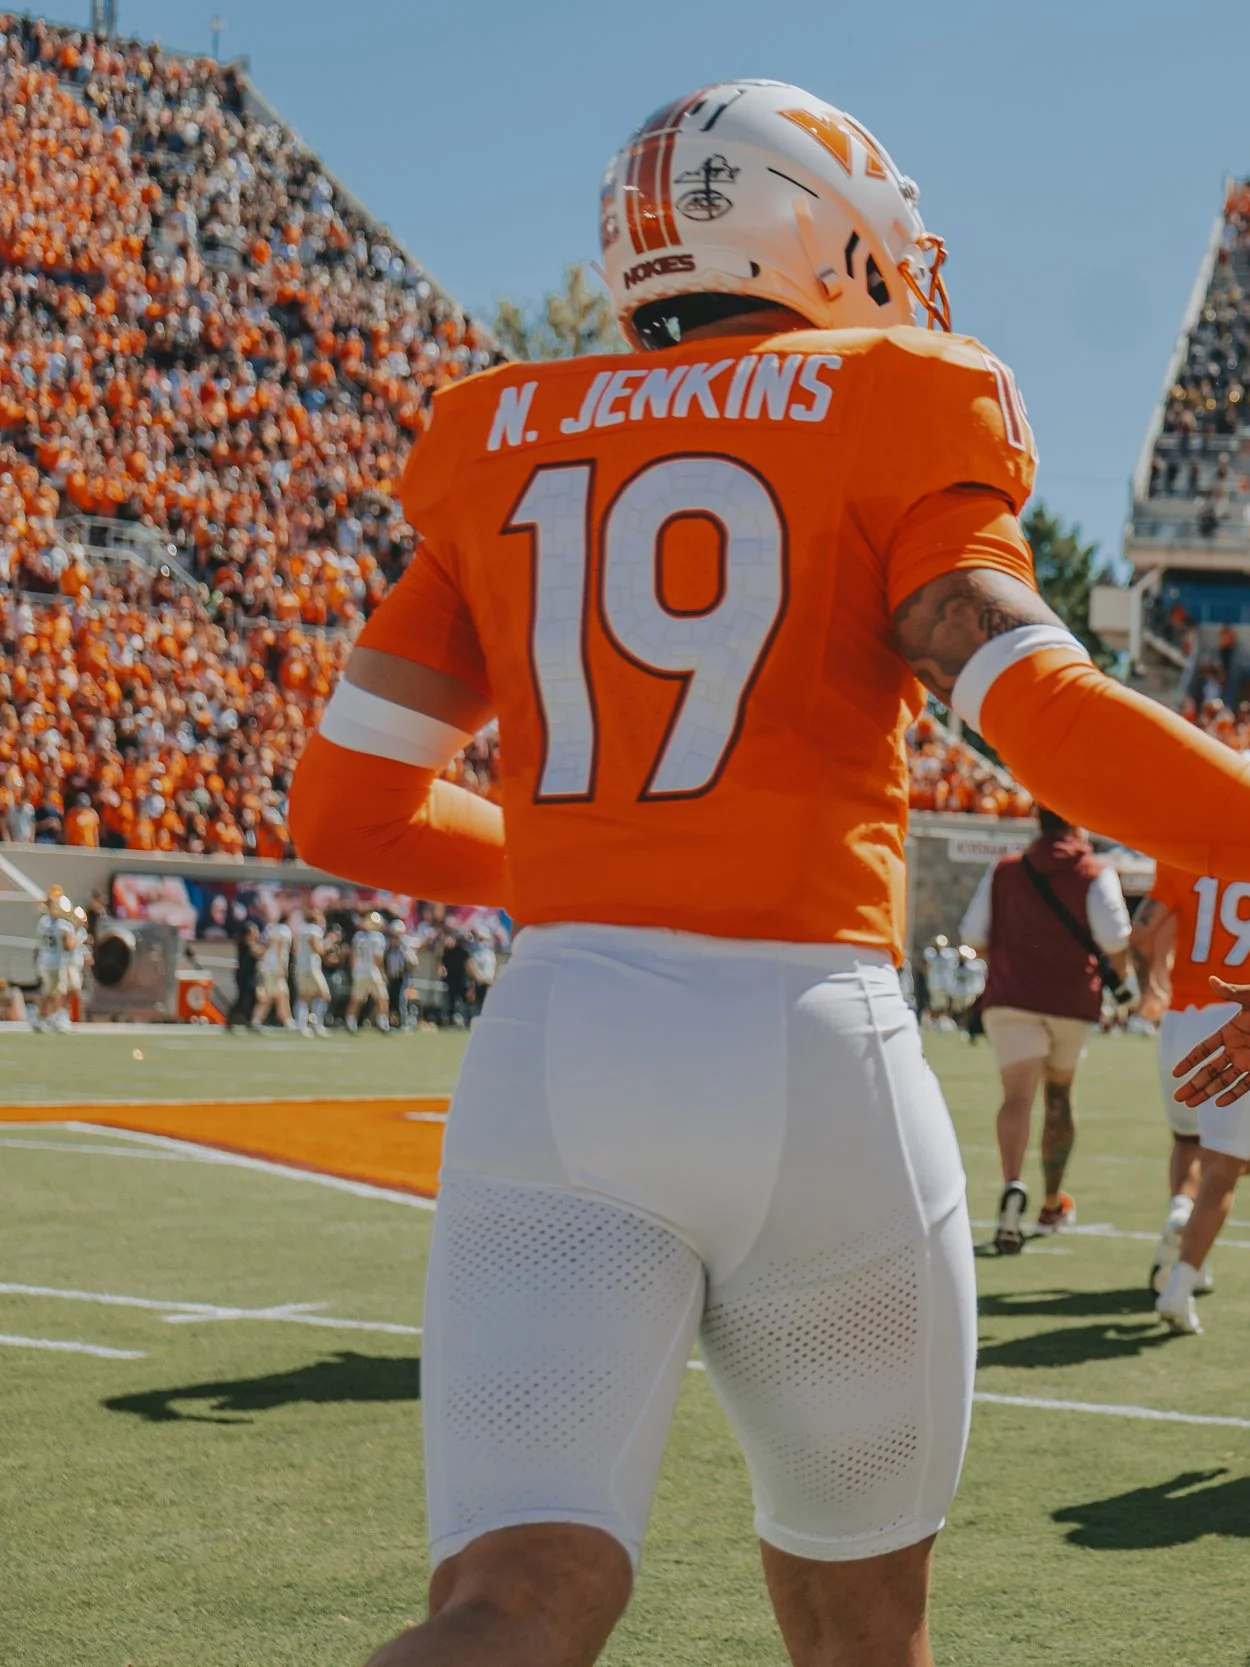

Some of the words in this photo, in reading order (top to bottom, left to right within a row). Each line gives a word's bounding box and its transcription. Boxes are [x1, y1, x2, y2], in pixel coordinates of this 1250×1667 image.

[487, 381, 539, 452] N.
[560, 353, 843, 435] JENKINS
[501, 450, 790, 805] 19
